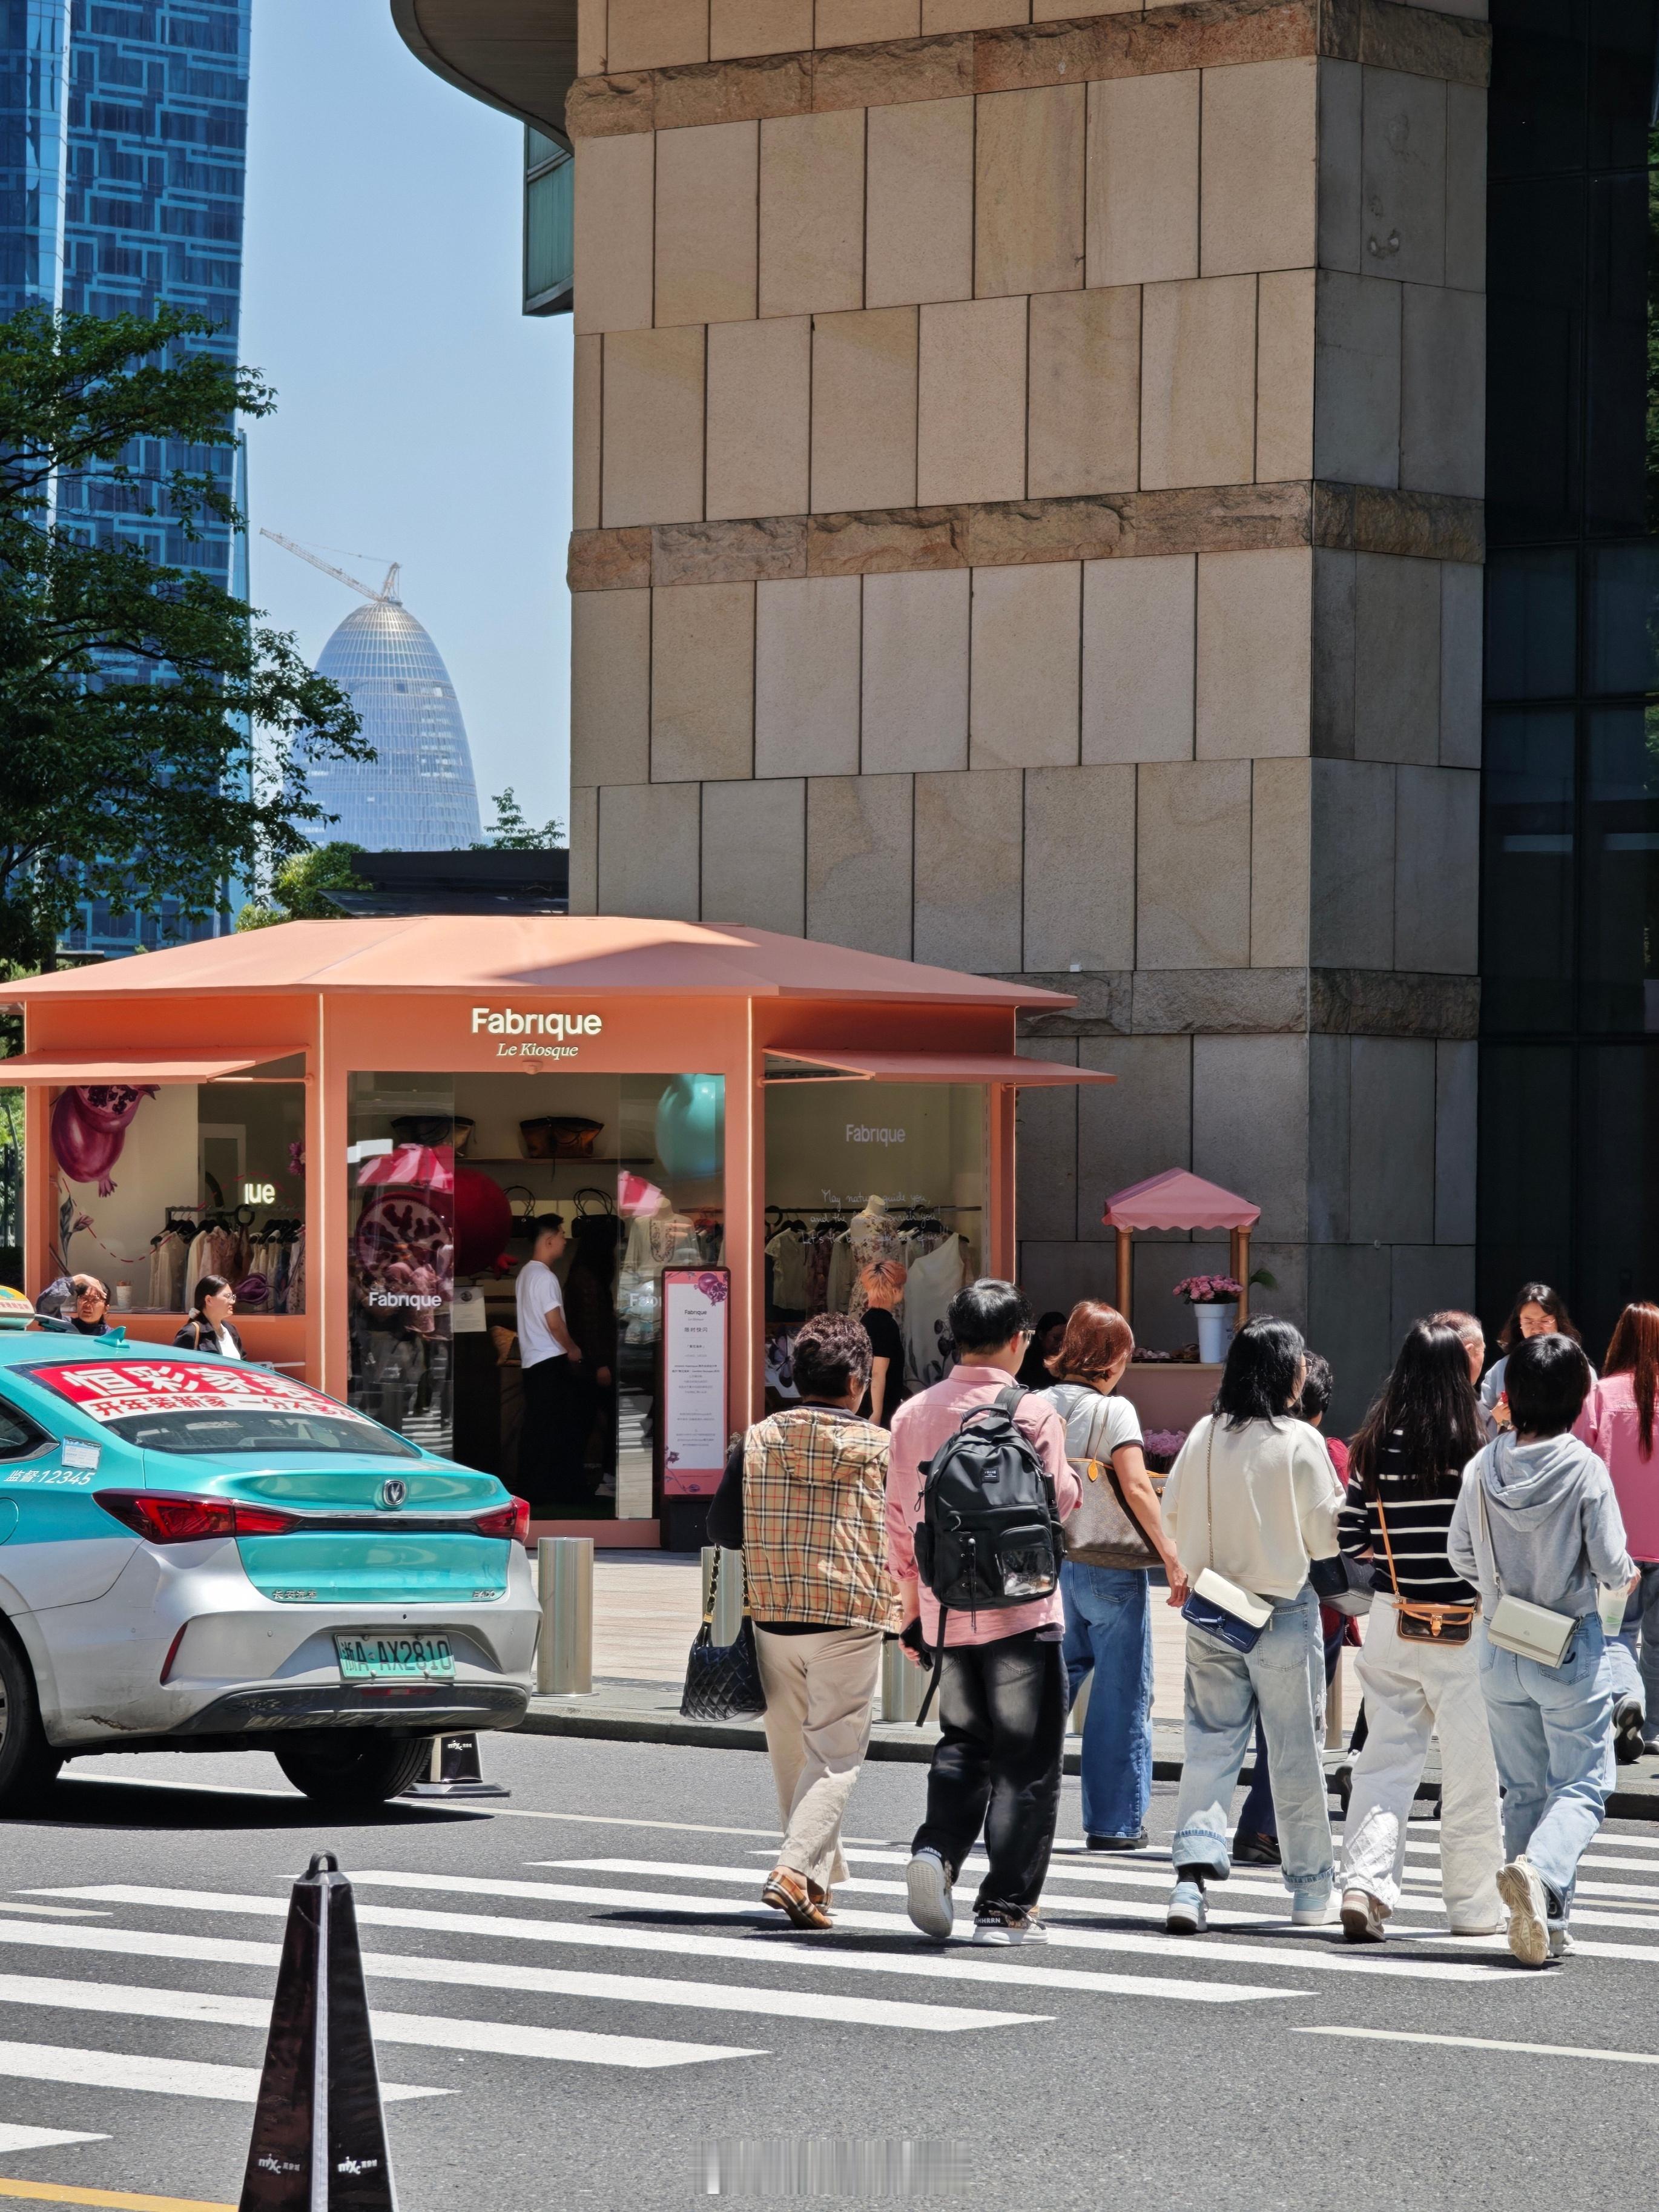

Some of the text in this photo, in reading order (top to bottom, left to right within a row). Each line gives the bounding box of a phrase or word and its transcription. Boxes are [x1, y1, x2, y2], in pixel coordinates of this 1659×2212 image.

[472, 1008, 602, 1042] Fabrique
[496, 1043, 579, 1060] Le Kiosque
[846, 1124, 906, 1147] Fabrique
[368, 1292, 442, 1310] Fabrique
[61, 1365, 326, 1402] 恒彩家装
[89, 1395, 234, 1416] 开年装新家
